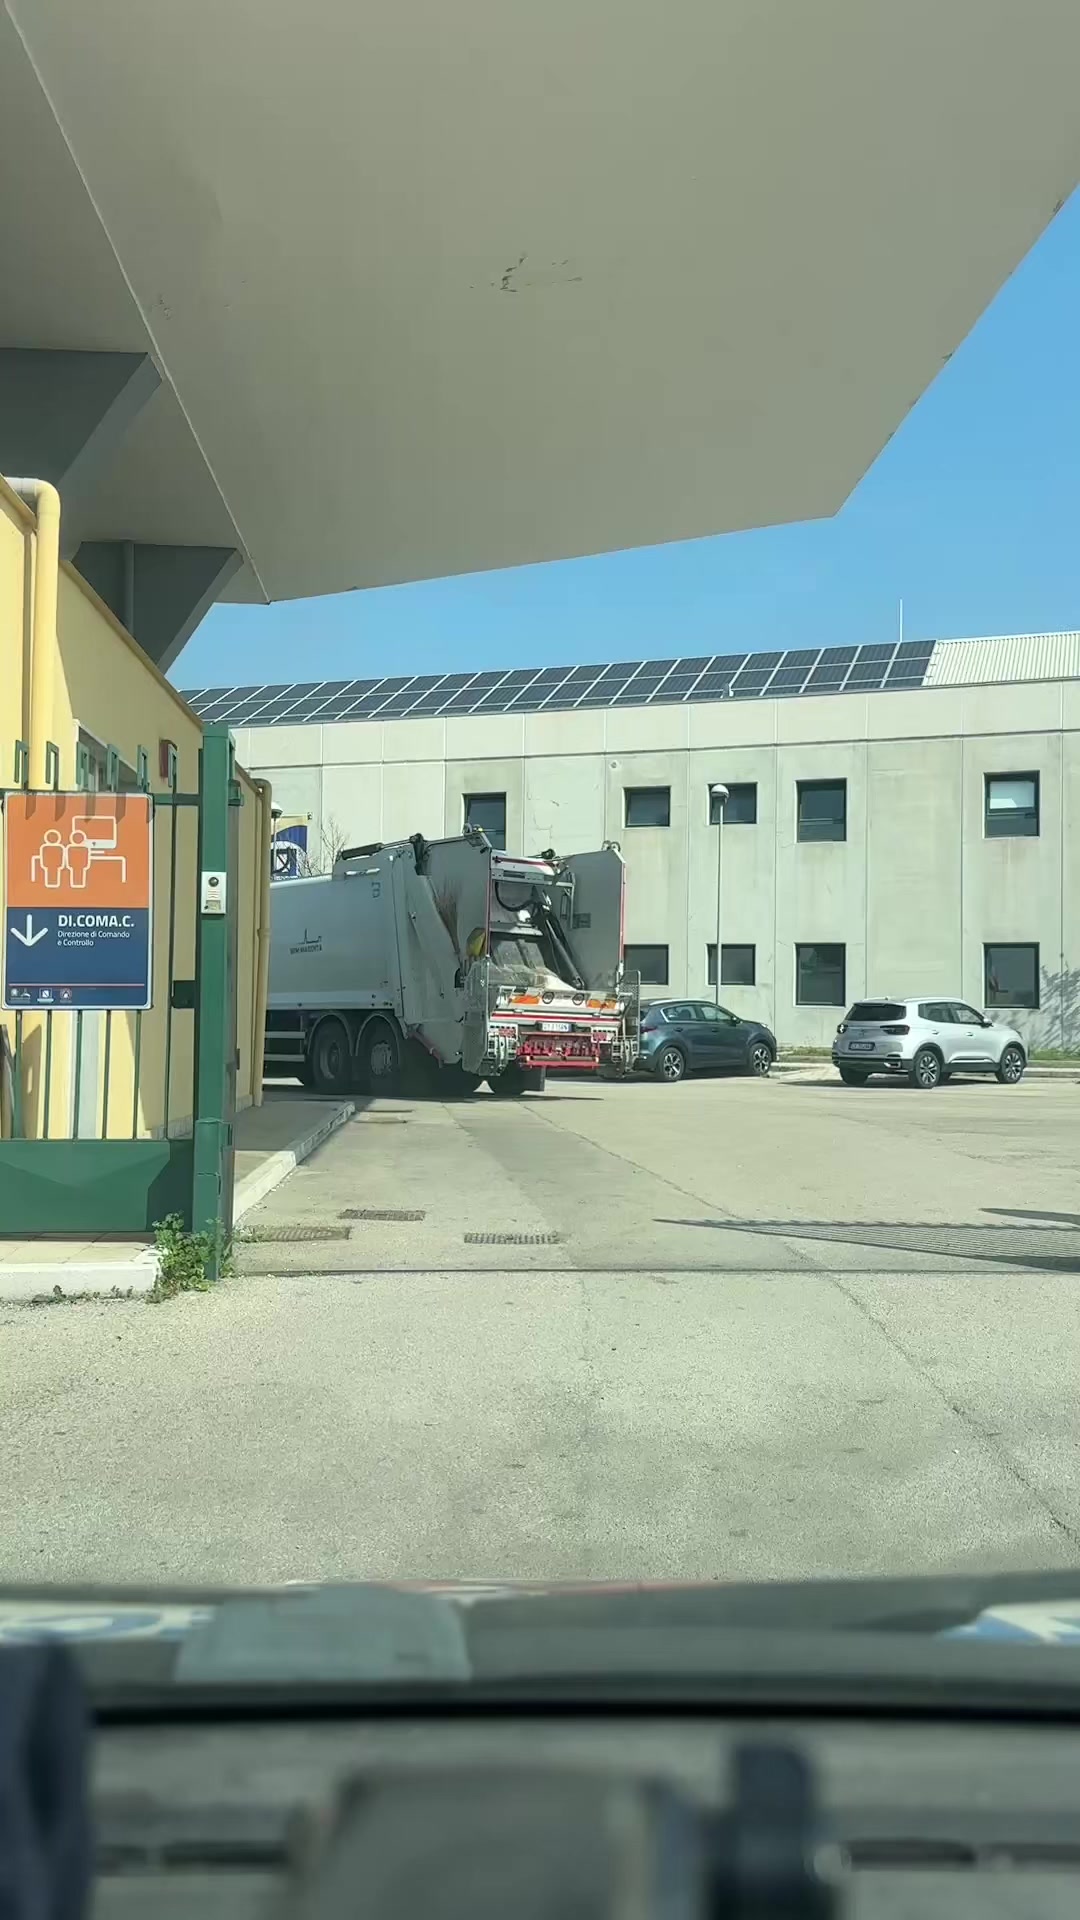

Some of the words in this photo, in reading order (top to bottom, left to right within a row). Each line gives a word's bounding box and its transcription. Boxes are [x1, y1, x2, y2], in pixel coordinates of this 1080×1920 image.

[58, 914, 135, 927] DI.COMA.C.
[57, 930, 90, 938] Direzione
[90, 930, 97, 938] di
[98, 930, 130, 938] Comando
[63, 938, 94, 946] Controllo
